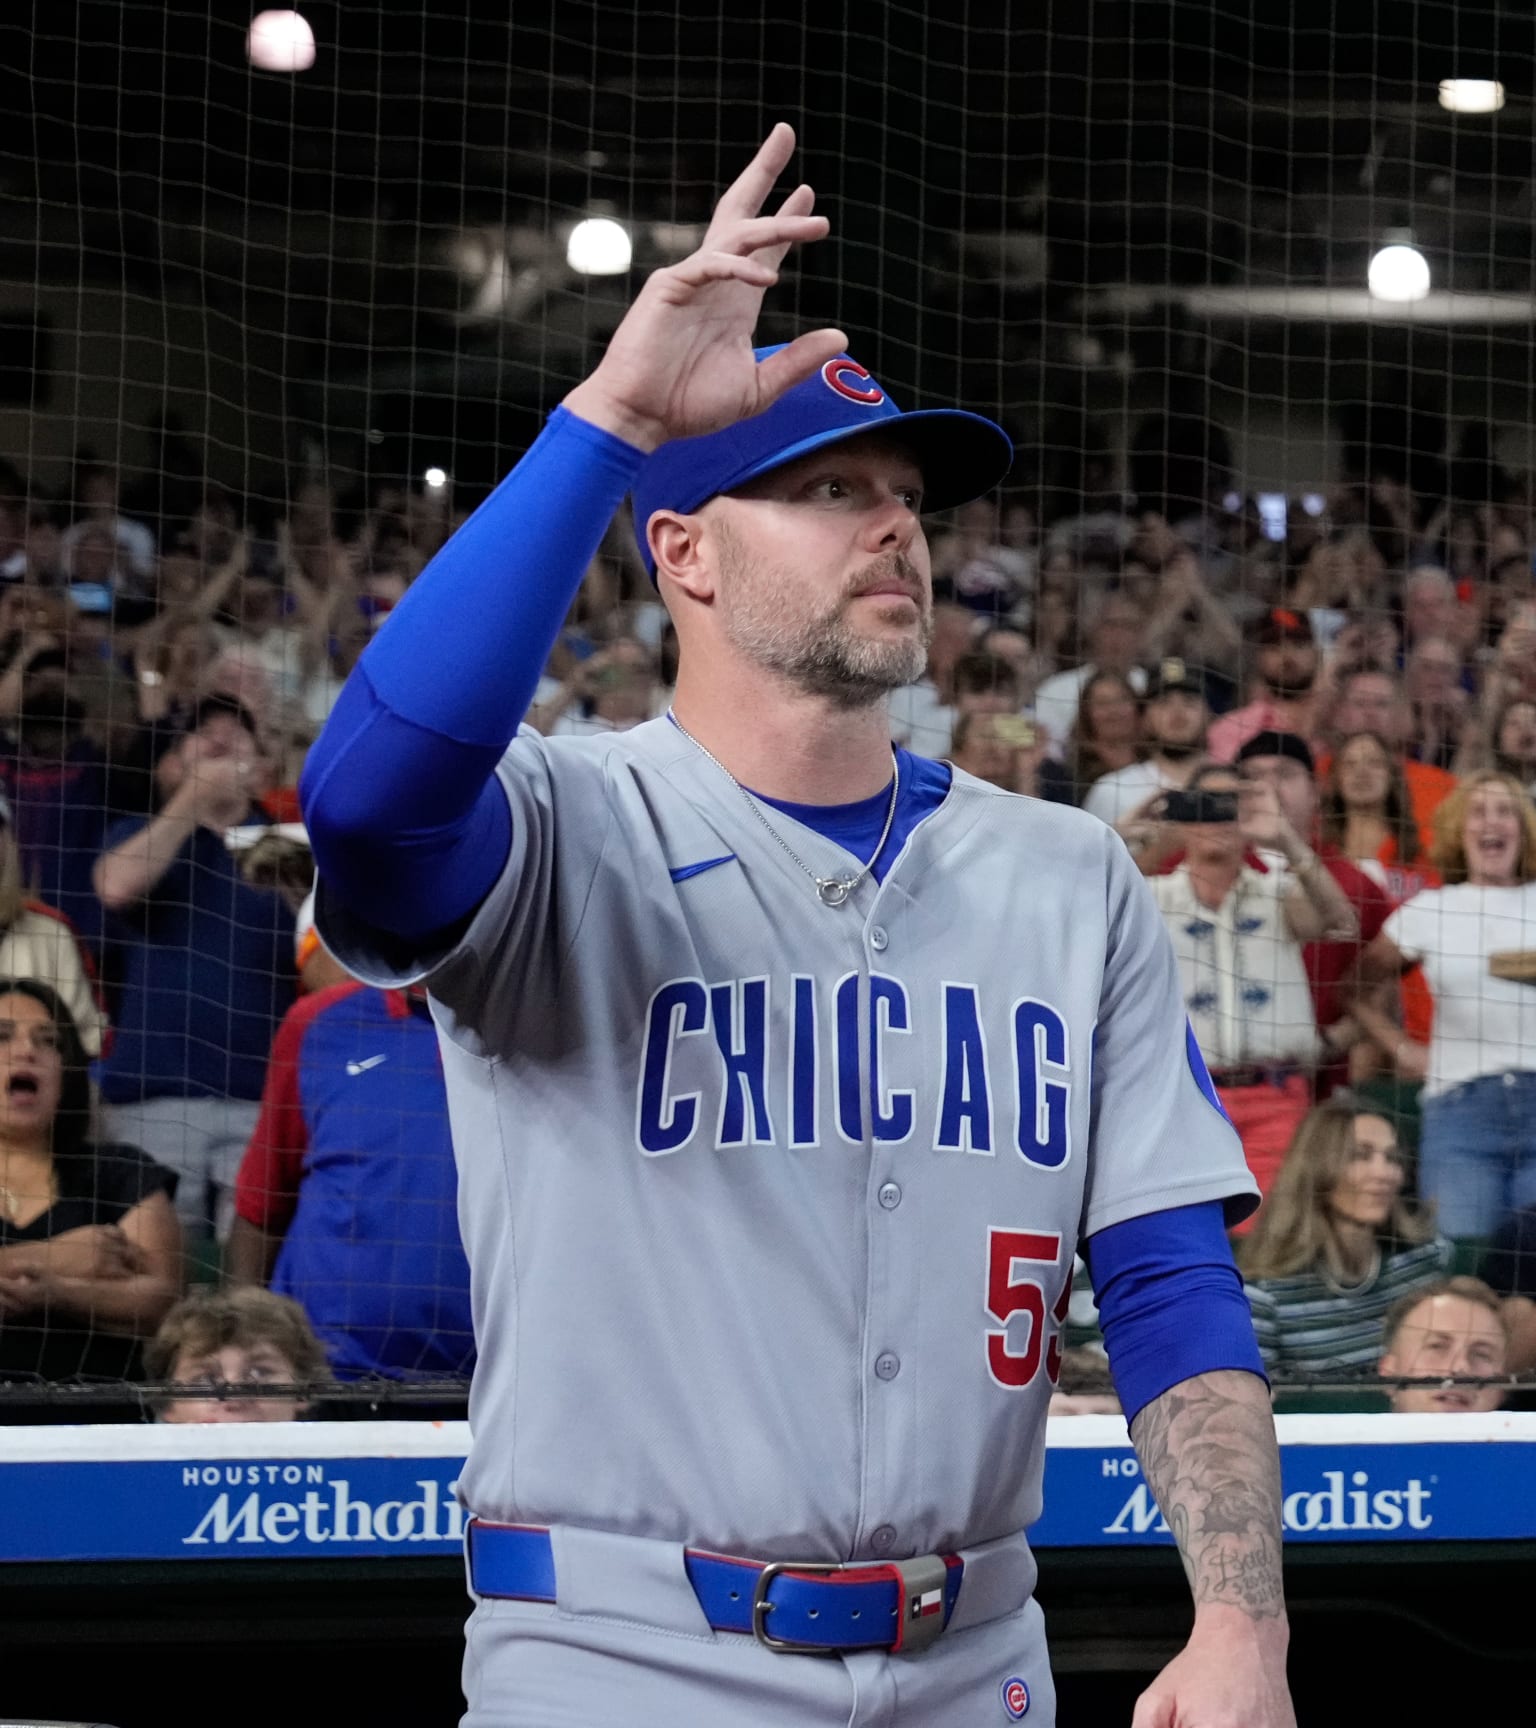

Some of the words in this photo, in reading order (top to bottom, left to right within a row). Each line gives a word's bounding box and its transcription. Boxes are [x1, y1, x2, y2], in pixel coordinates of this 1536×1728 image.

[821, 359, 884, 406] C
[635, 969, 1098, 1172] CHICAG
[182, 1465, 323, 1486] HOUSTON
[181, 1480, 464, 1544] Methodi
